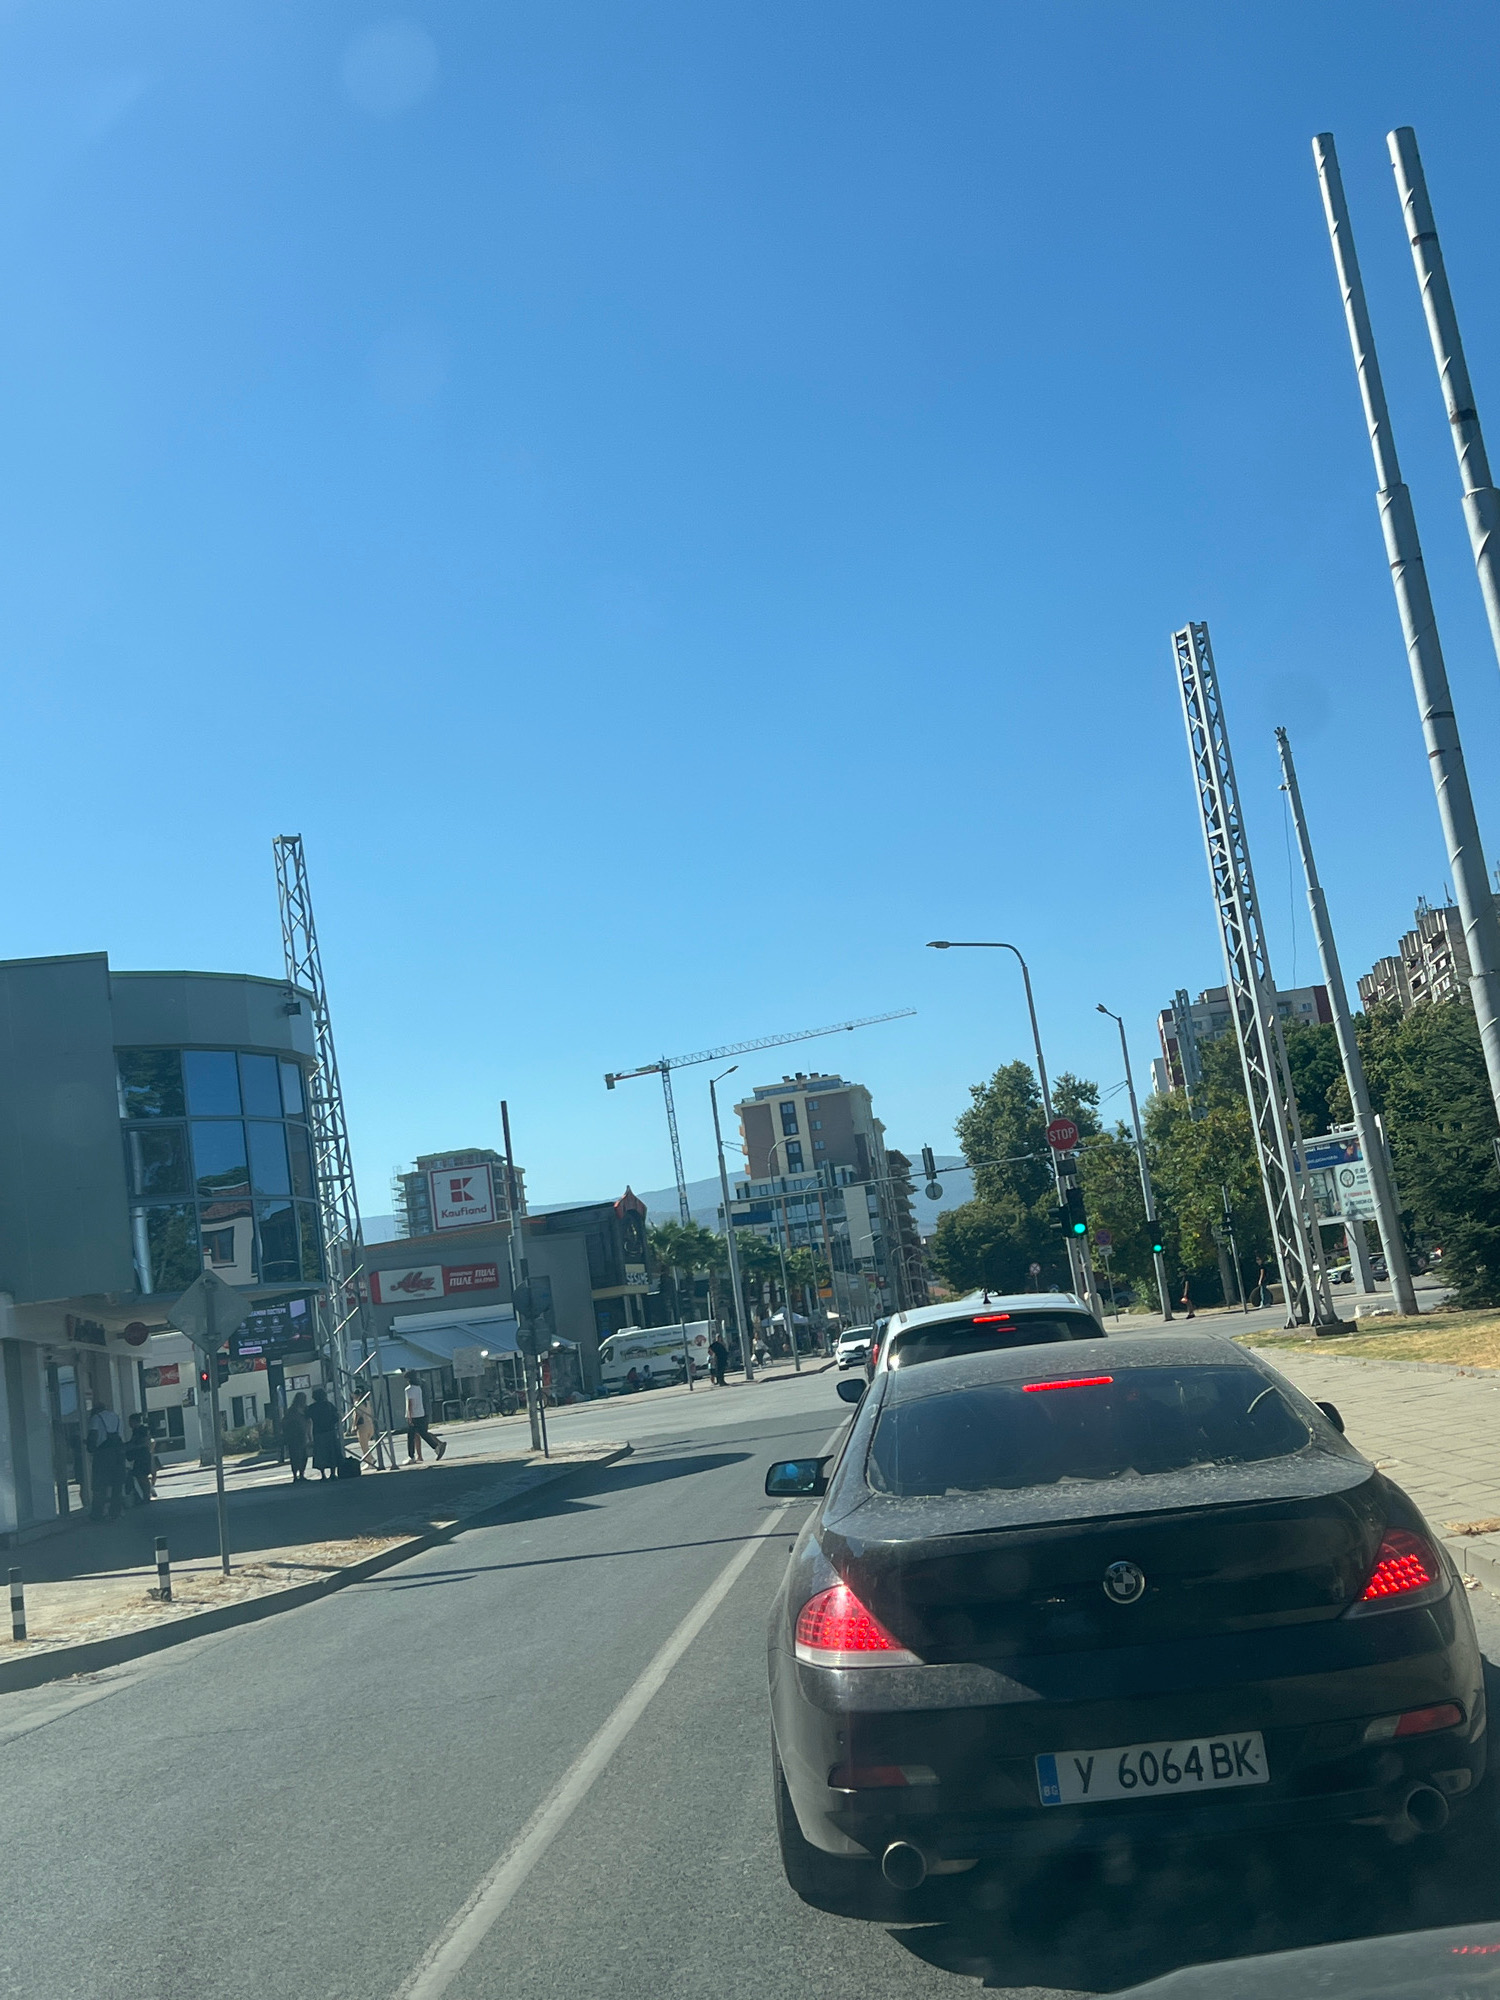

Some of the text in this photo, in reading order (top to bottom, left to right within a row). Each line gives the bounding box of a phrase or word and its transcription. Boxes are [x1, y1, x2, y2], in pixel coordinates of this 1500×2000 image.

[1049, 1127, 1075, 1142] STOP
[442, 1204, 487, 1218] Kaufland
[1073, 1755, 1095, 1794] Y
[1043, 1785, 1059, 1797] BG
